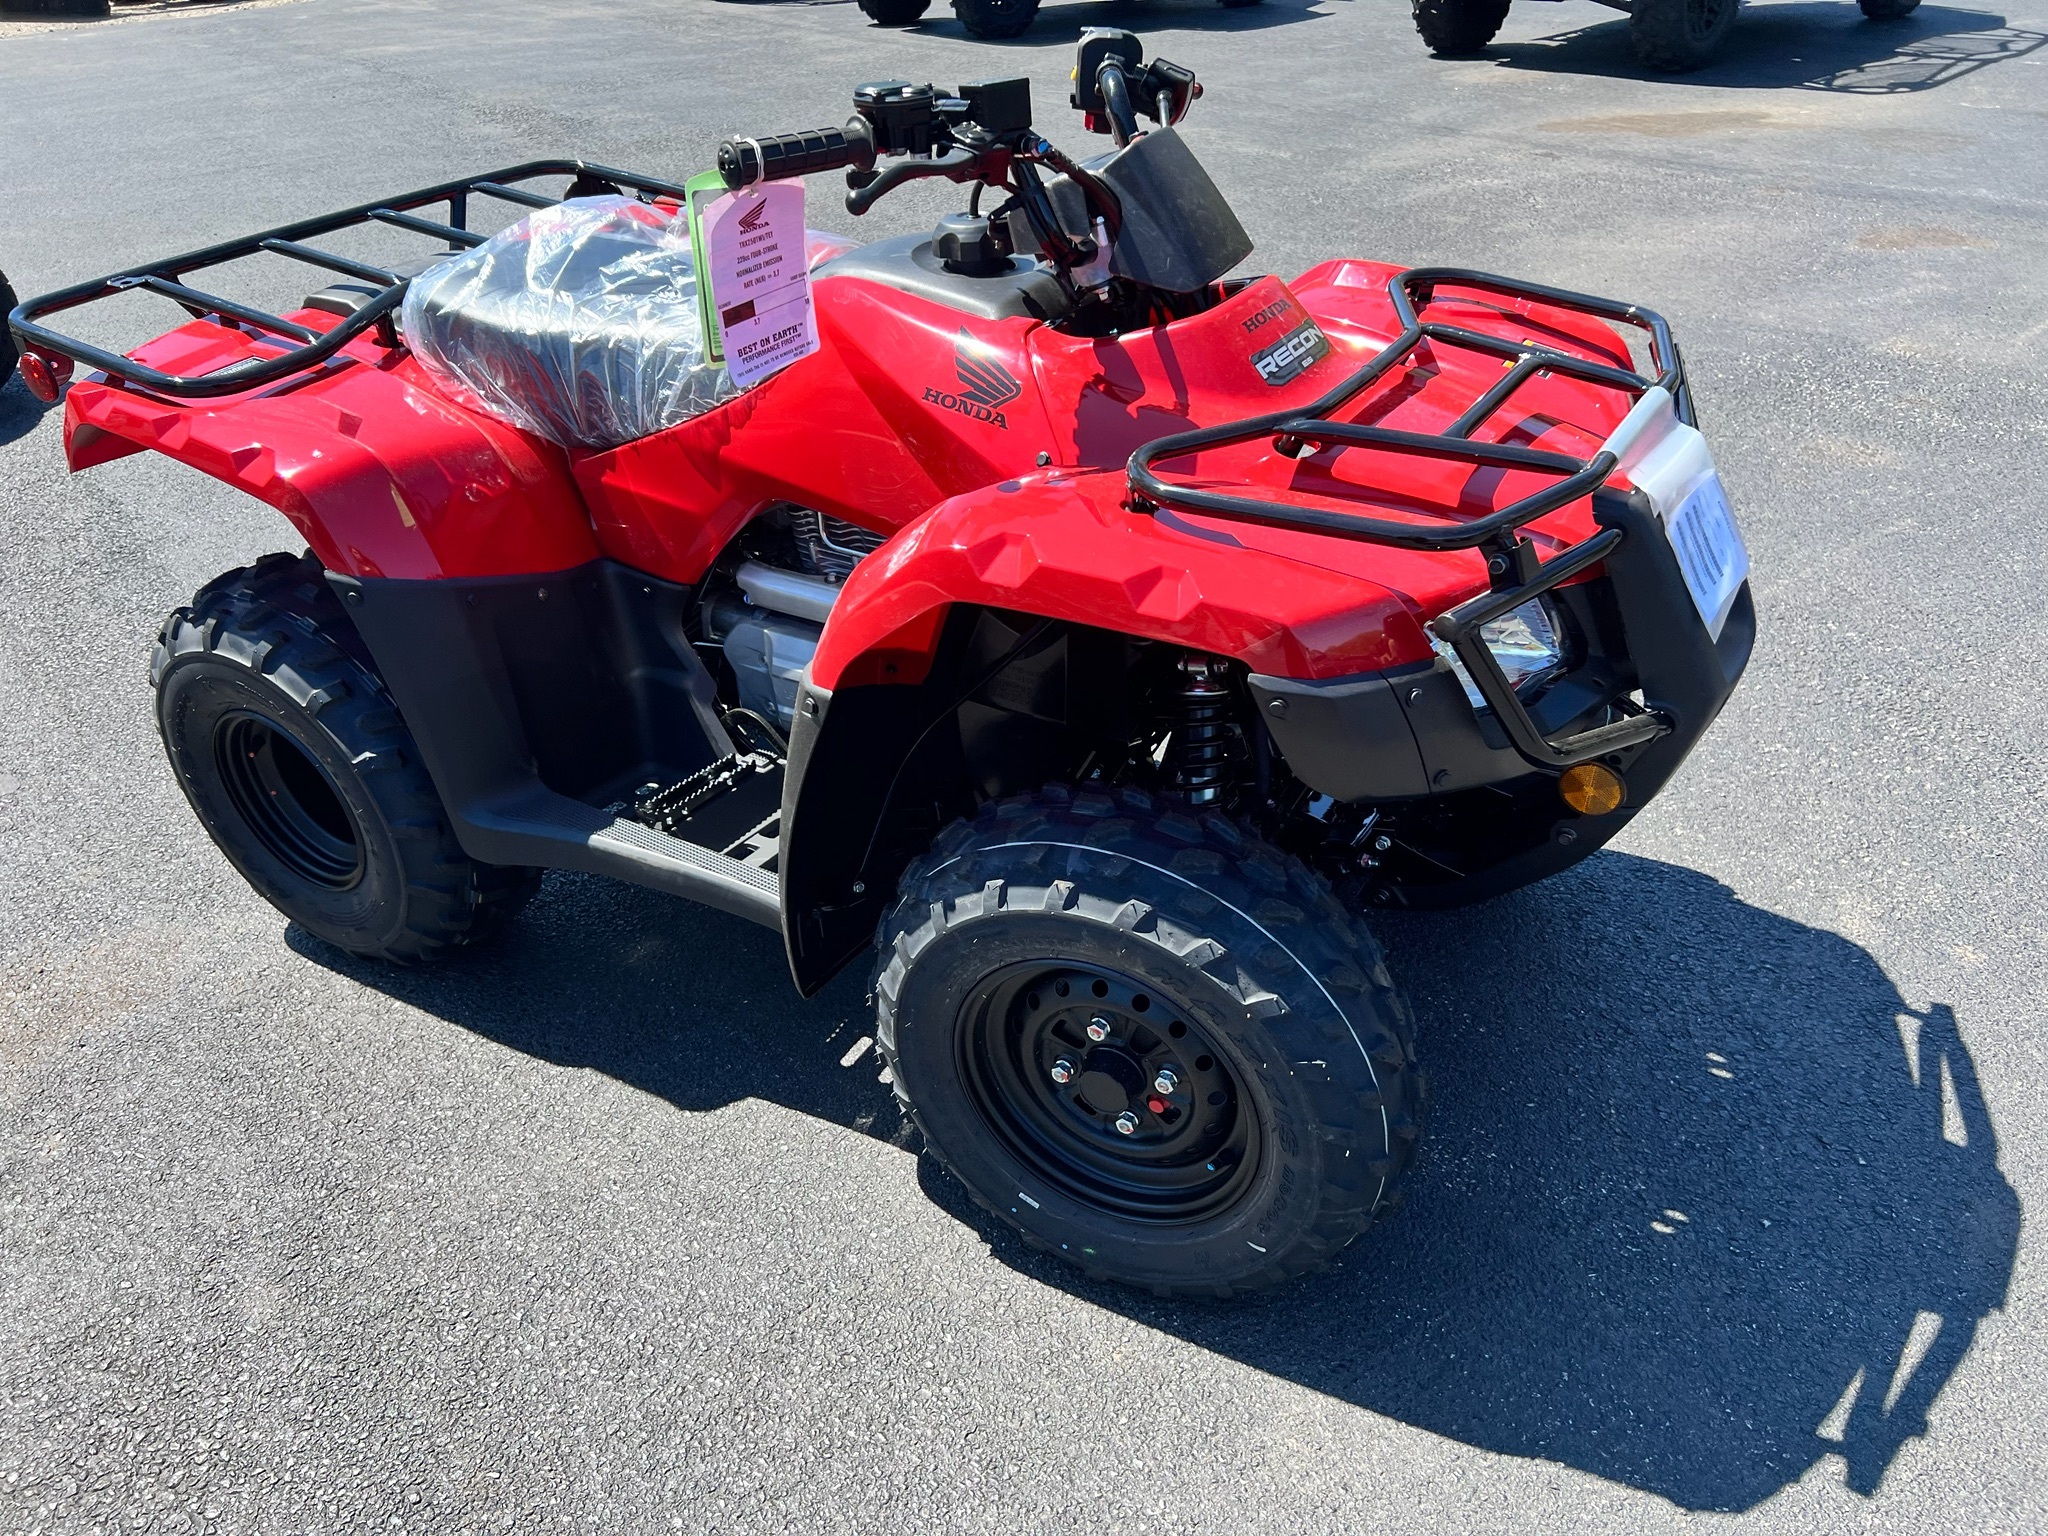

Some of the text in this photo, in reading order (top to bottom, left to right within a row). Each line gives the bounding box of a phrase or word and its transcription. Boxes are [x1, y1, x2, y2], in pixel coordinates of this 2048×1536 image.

[740, 222, 770, 235] HONDA
[737, 243, 778, 264] 229cc FOUR-STROKE
[736, 255, 783, 278] NORMALIZED EMISSION
[743, 279, 754, 289] RATE
[754, 275, 766, 285] (NER)
[1242, 298, 1292, 334] HONDA
[737, 341, 757, 358] BEST
[760, 336, 771, 348] ON
[742, 342, 780, 365] PERFORMANCE
[1255, 325, 1325, 380] RECON
[922, 387, 1008, 430] HONDA
[1145, 968, 1299, 1157] MAXXIS
